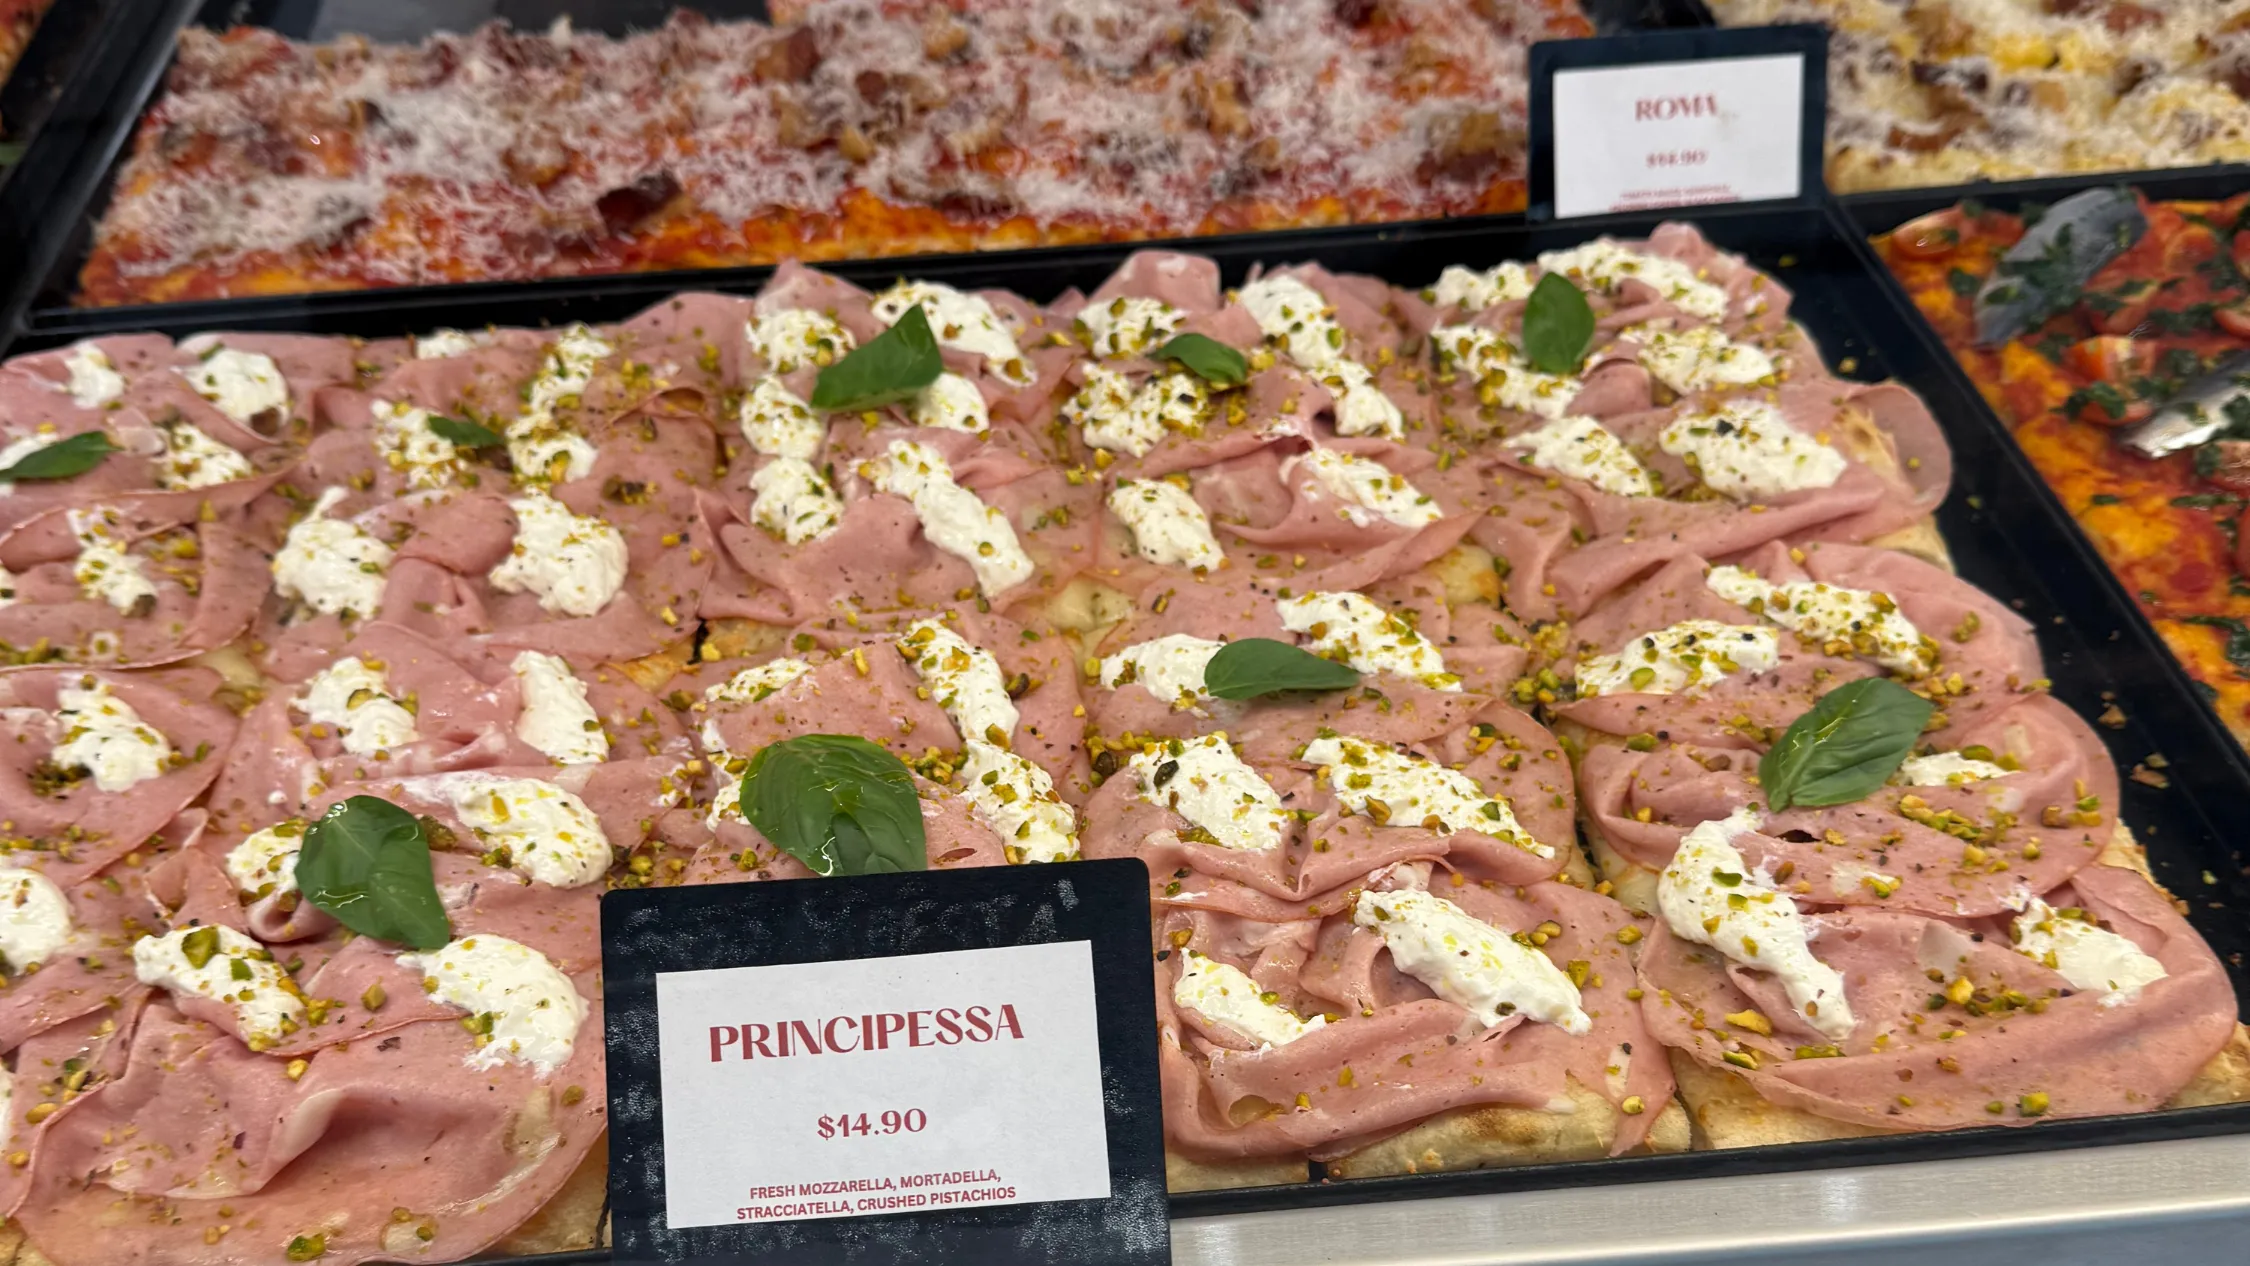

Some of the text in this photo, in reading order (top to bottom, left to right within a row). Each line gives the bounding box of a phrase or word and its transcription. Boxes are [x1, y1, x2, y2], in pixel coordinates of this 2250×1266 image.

[1635, 94, 1719, 121] ROMA
[709, 1004, 1024, 1062] PRINCIPESSA
[817, 1108, 927, 1140] $14.90
[750, 1169, 1002, 1200] FRESH MOZZARELLA, MORTADELLA,
[736, 1186, 1016, 1220] STRACCIATELLA, CRUSHED PISTACHIOS
